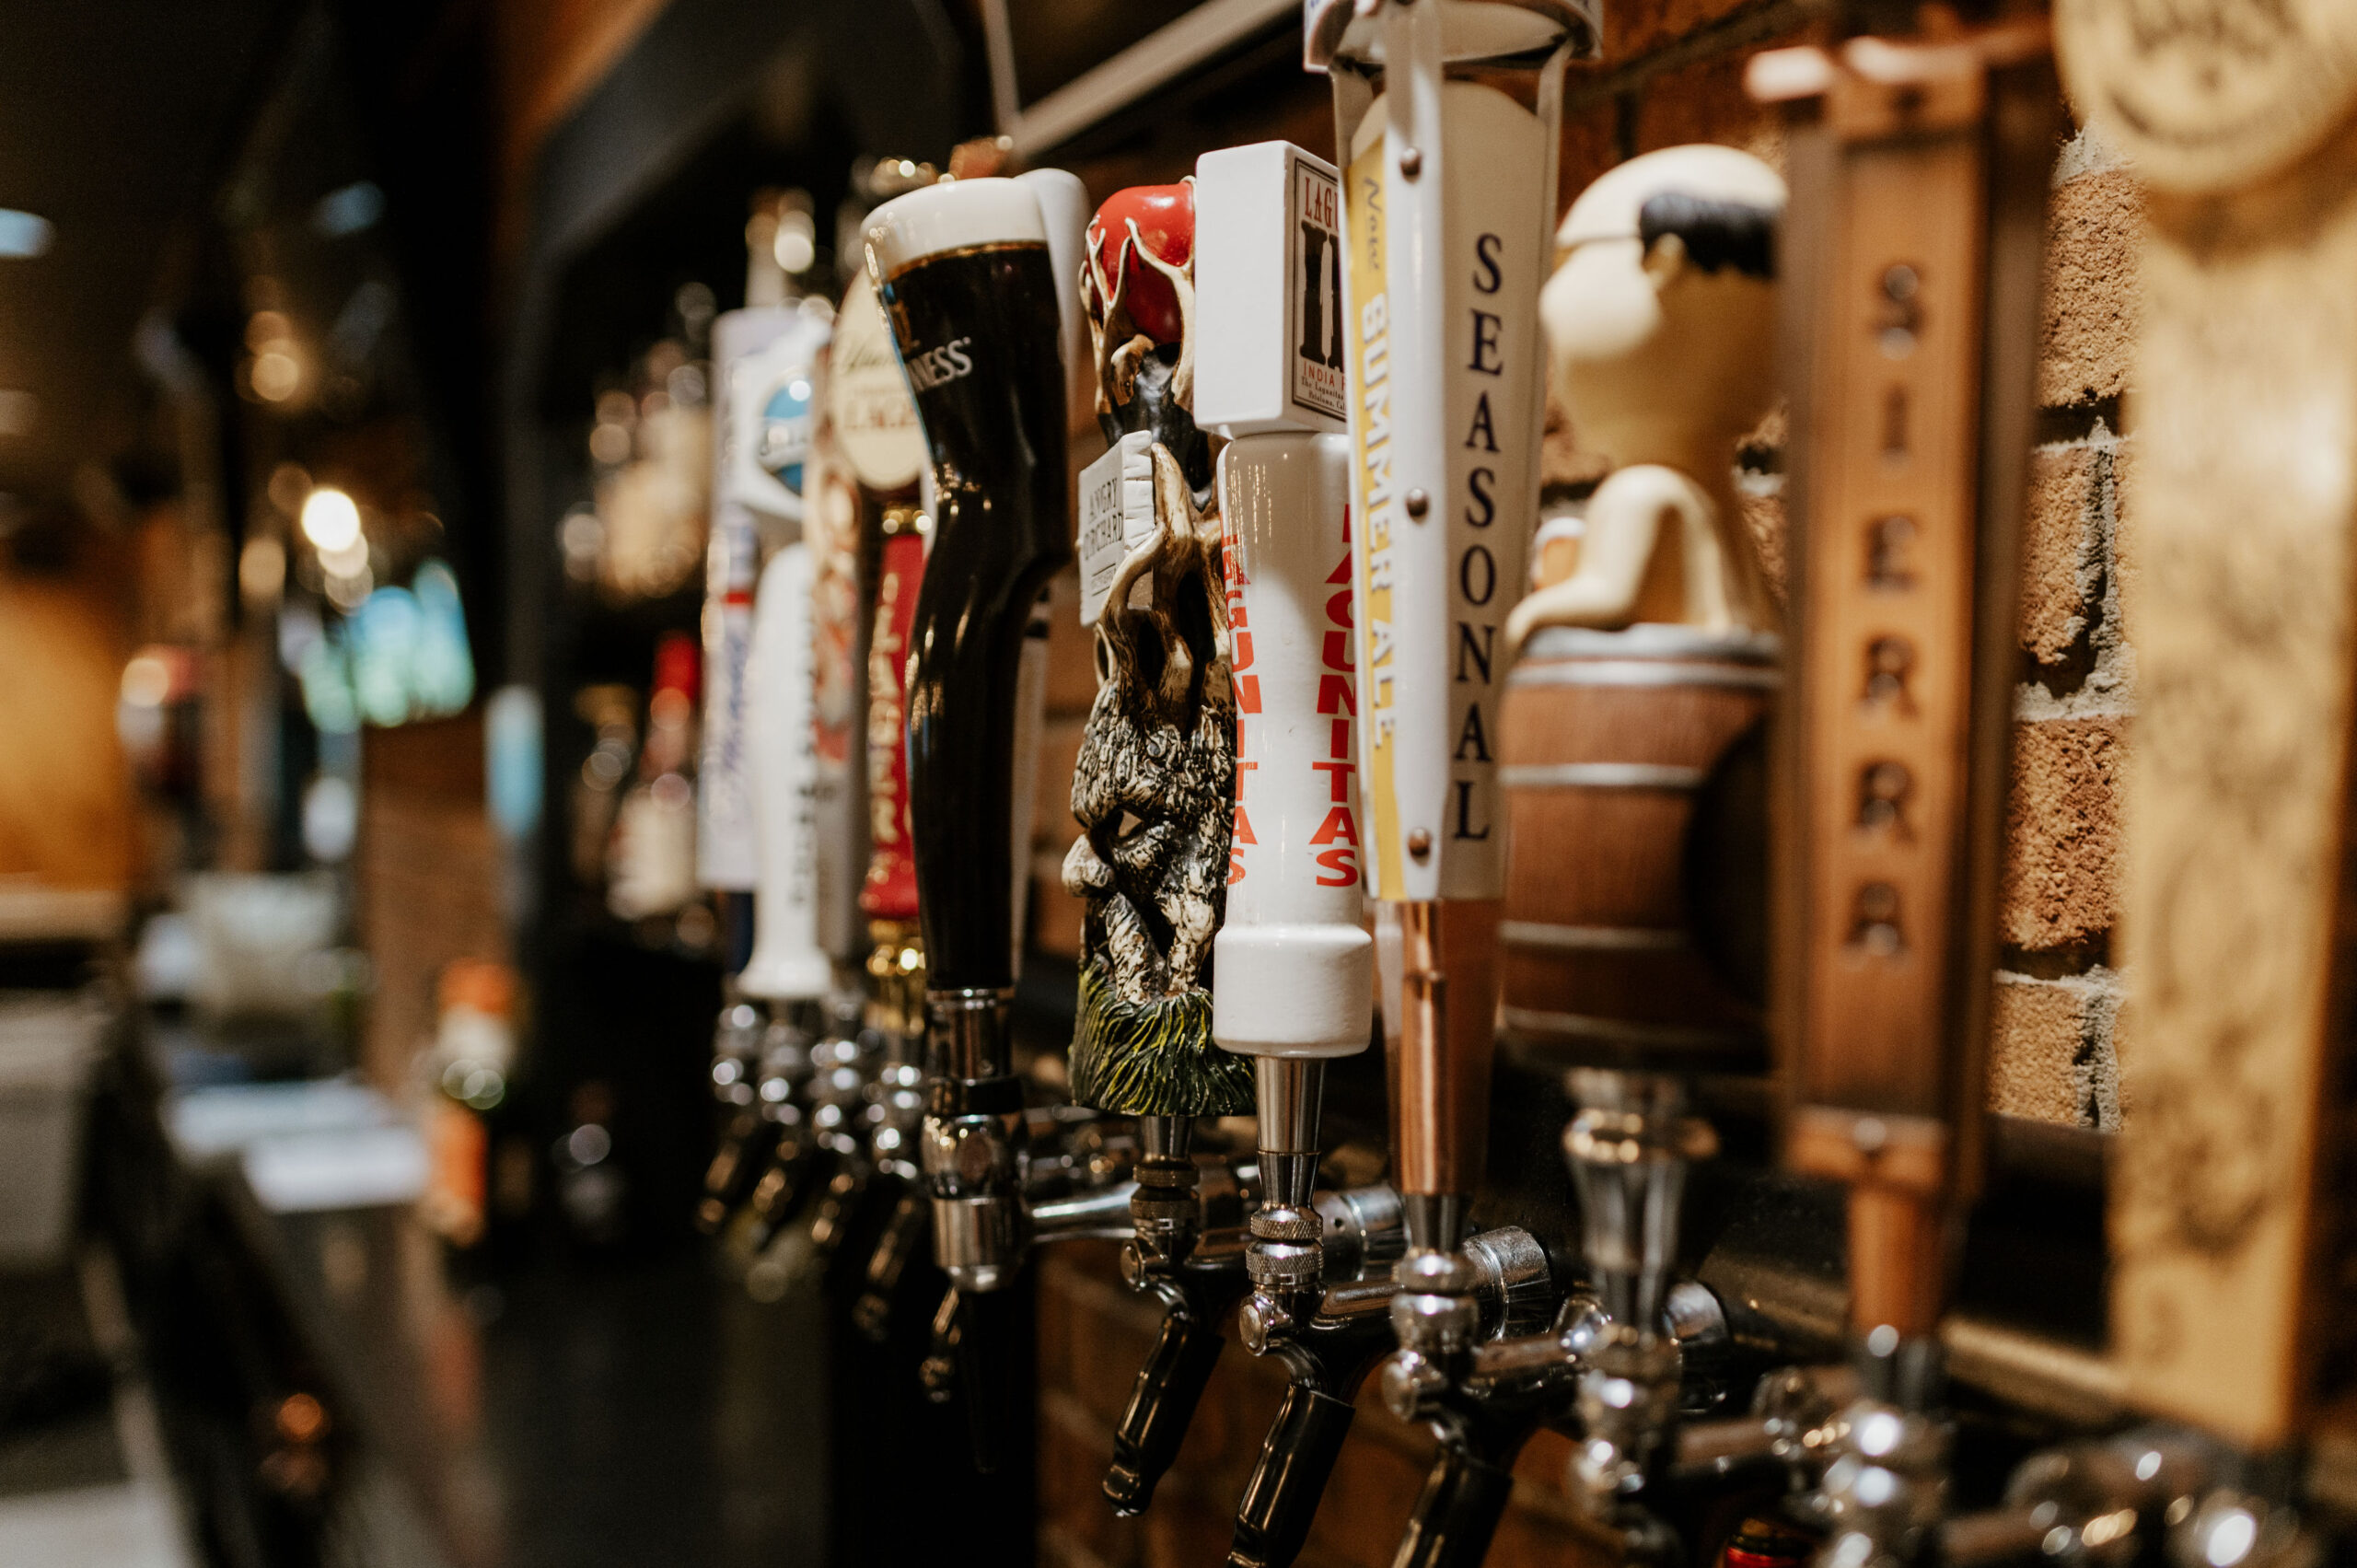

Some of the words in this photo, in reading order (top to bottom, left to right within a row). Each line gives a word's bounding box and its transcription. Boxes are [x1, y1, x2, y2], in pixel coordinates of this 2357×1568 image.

[1304, 360, 1335, 388] INDIA
[1362, 293, 1394, 594] SUMMER
[1083, 512, 1123, 561] ORCHARD
[1089, 477, 1118, 524] ANGRY
[1454, 233, 1504, 842] SEASONAL
[1308, 503, 1359, 887] GUNITAS
[1372, 618, 1396, 749] ALE
[1845, 262, 1925, 968] SIERRA
